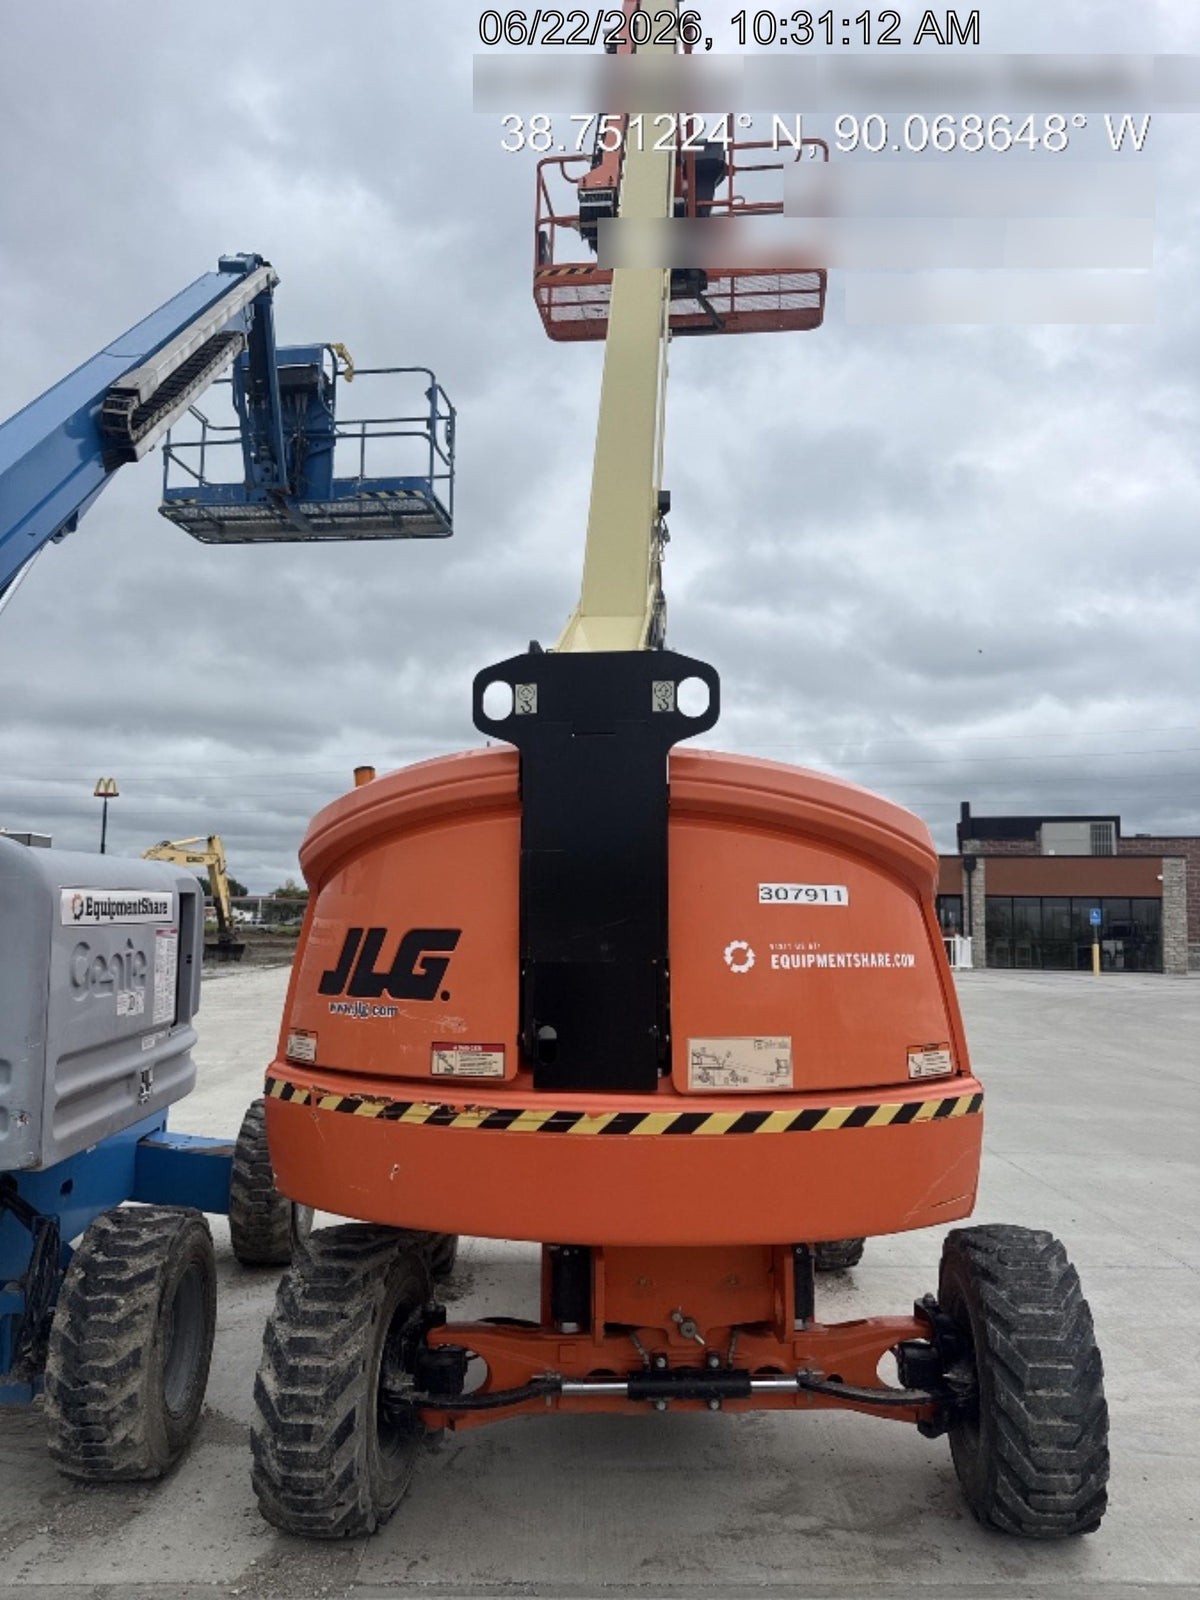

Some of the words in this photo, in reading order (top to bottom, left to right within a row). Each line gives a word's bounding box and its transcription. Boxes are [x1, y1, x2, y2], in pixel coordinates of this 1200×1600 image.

[760, 886, 843, 903] 307911
[85, 896, 168, 921] EquipmentShare
[71, 938, 147, 1002] Genie
[771, 953, 916, 970] EQUIPMENTSHARE.COM
[329, 1001, 398, 1019] www.jlg.com
